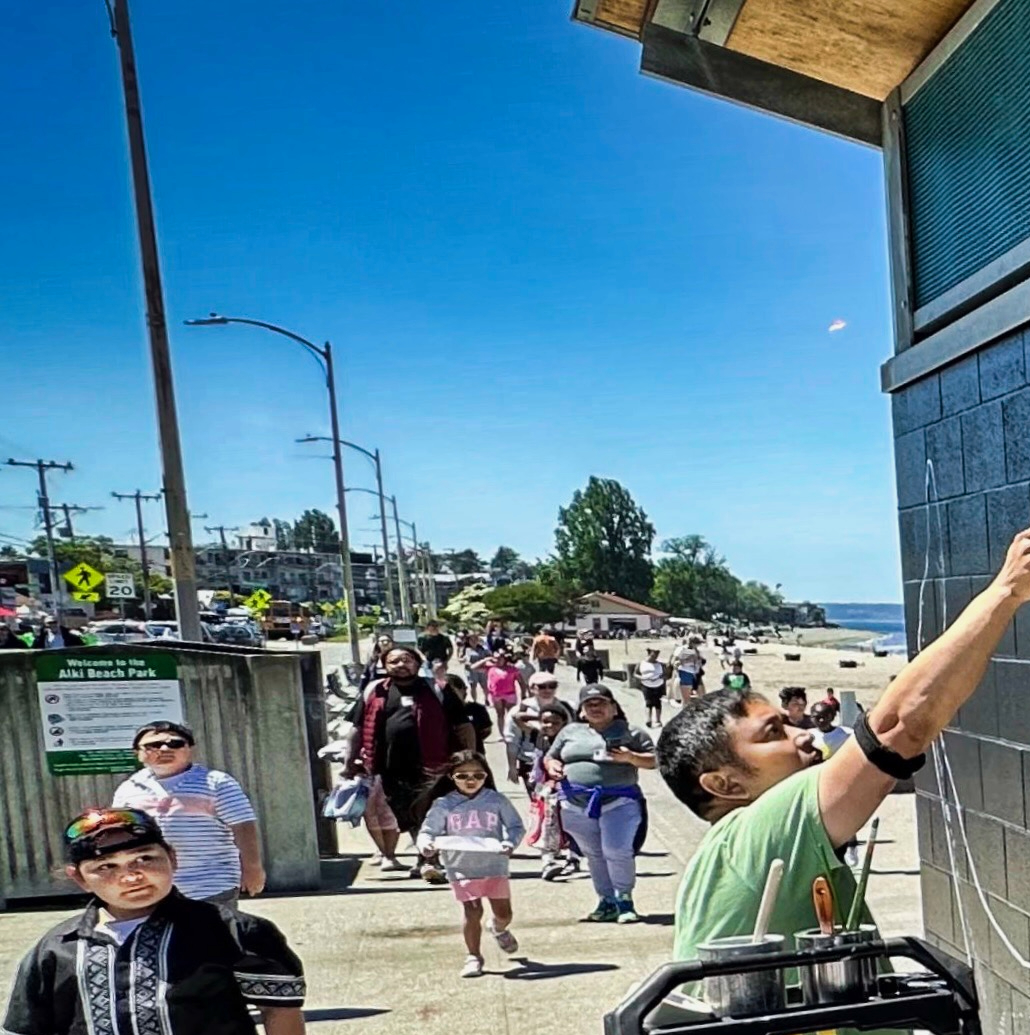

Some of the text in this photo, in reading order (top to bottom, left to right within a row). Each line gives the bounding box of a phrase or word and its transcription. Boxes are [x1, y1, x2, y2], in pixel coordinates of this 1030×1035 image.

[109, 585, 132, 595] 20
[66, 658, 145, 667] Welcome to the
[59, 667, 157, 678] Alki Beach Park
[449, 810, 498, 831] GAP
